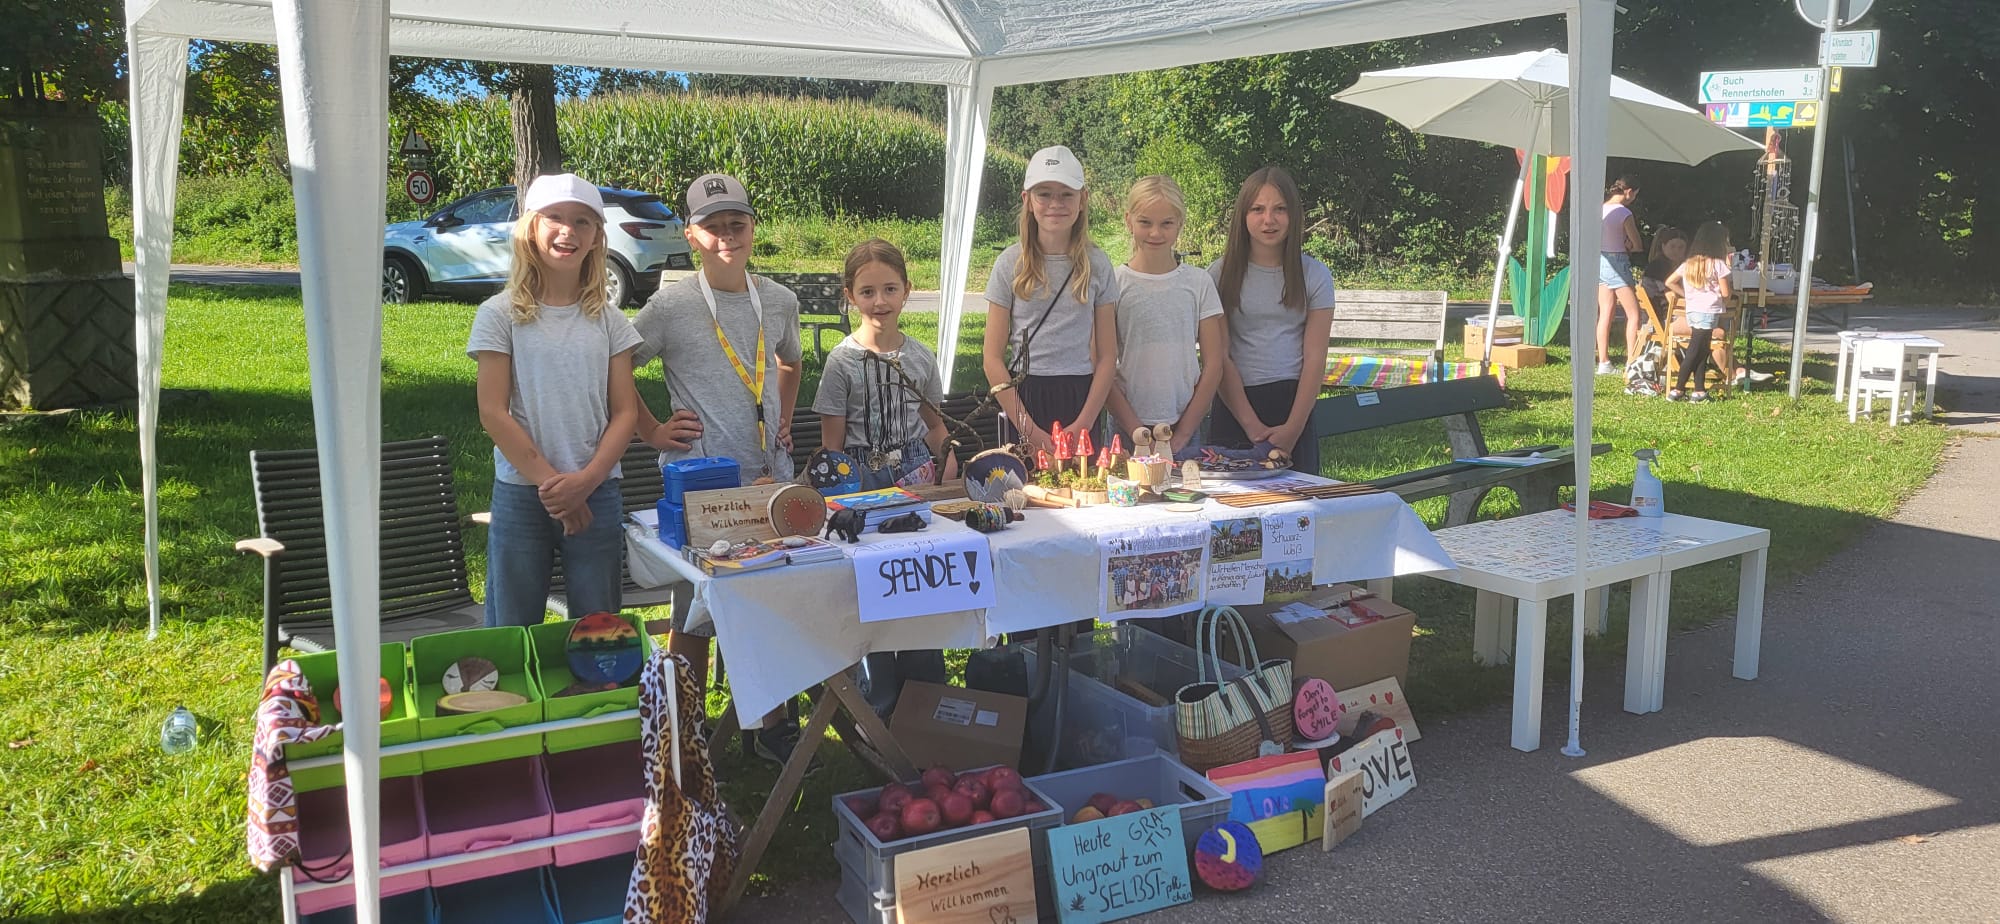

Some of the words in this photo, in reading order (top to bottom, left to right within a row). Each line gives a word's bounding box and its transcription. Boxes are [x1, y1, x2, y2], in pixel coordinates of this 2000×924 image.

[1721, 88, 1785, 98] Rennertshofen
[1722, 76, 1744, 86] Buch
[412, 180, 428, 195] 50
[701, 500, 752, 515] Herzlich
[1302, 682, 1325, 703] Don't
[1298, 698, 1320, 720] forget
[1320, 695, 1329, 705] to
[1311, 711, 1338, 734] SMILE
[1360, 742, 1411, 799] OVE
[1073, 824, 1112, 856] Heute
[1144, 824, 1172, 848] TIS
[916, 860, 981, 891] Herzlich
[1062, 847, 1129, 895] Ungraut
[1133, 851, 1163, 867] zum
[931, 885, 1009, 913] Willkommen
